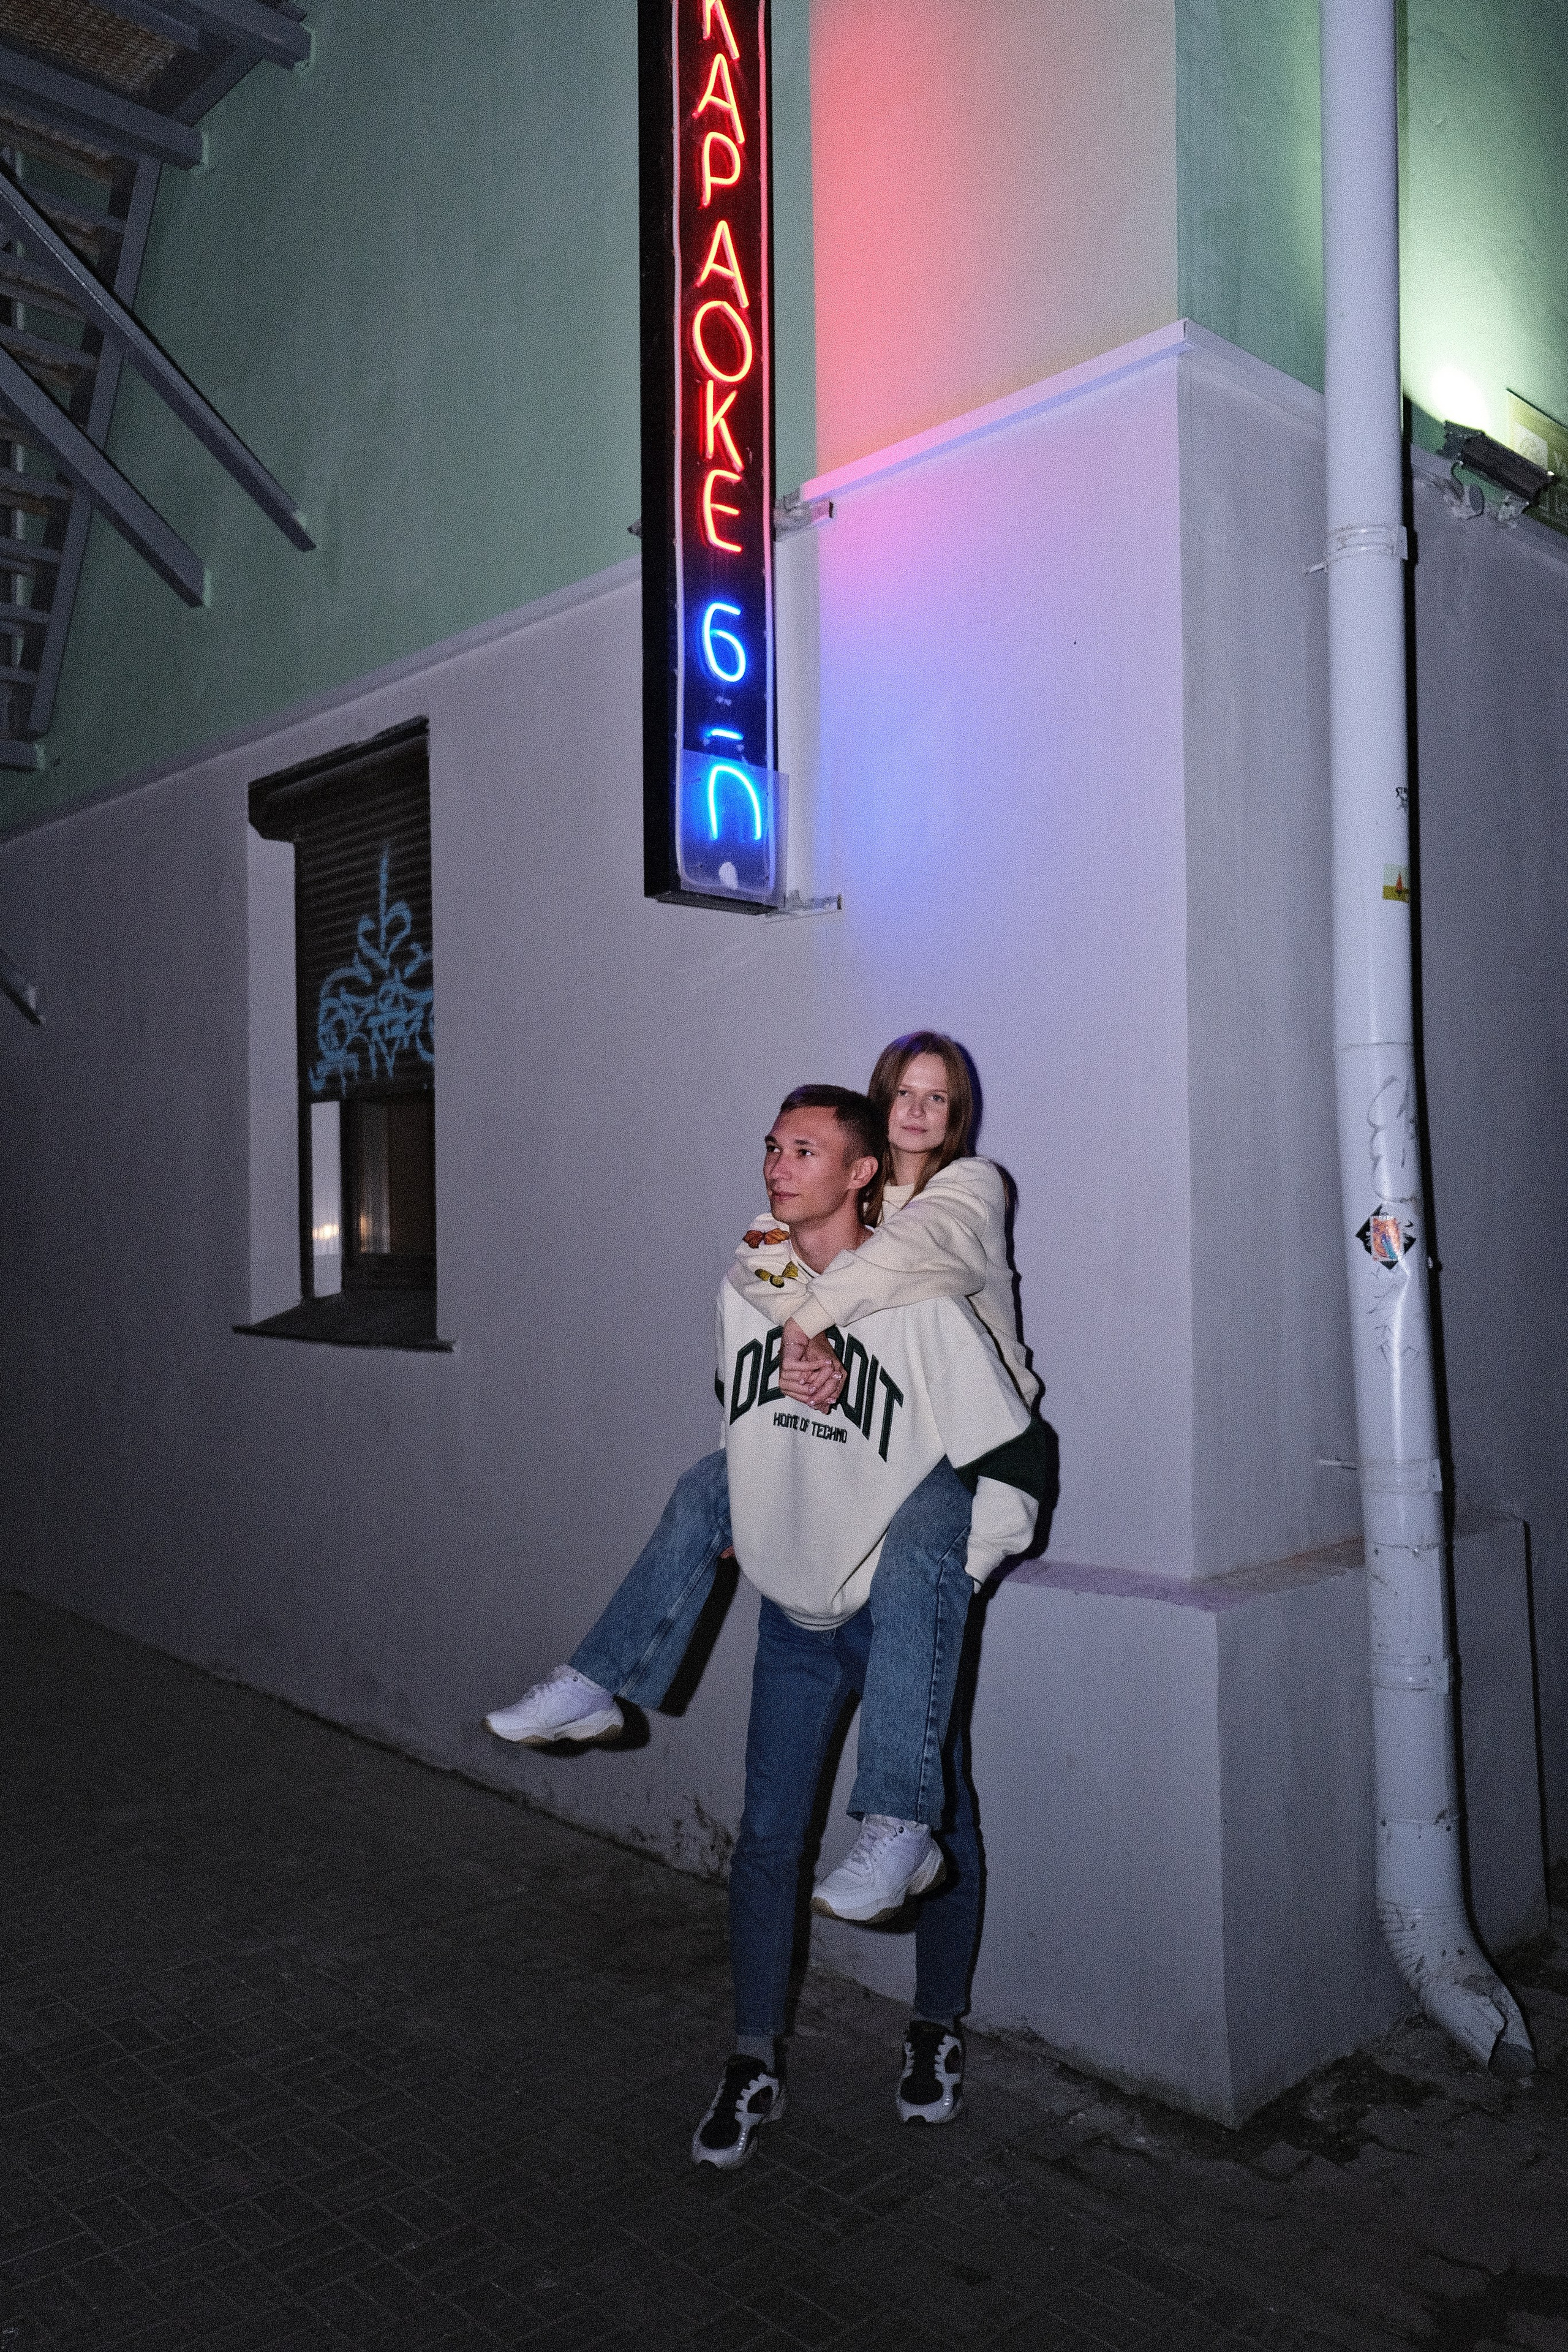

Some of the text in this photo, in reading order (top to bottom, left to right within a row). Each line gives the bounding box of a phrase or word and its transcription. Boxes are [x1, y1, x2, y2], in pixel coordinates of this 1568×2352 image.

[729, 1325, 904, 1463] DEOIT
[773, 1412, 848, 1444] HOME OF TECHNO
